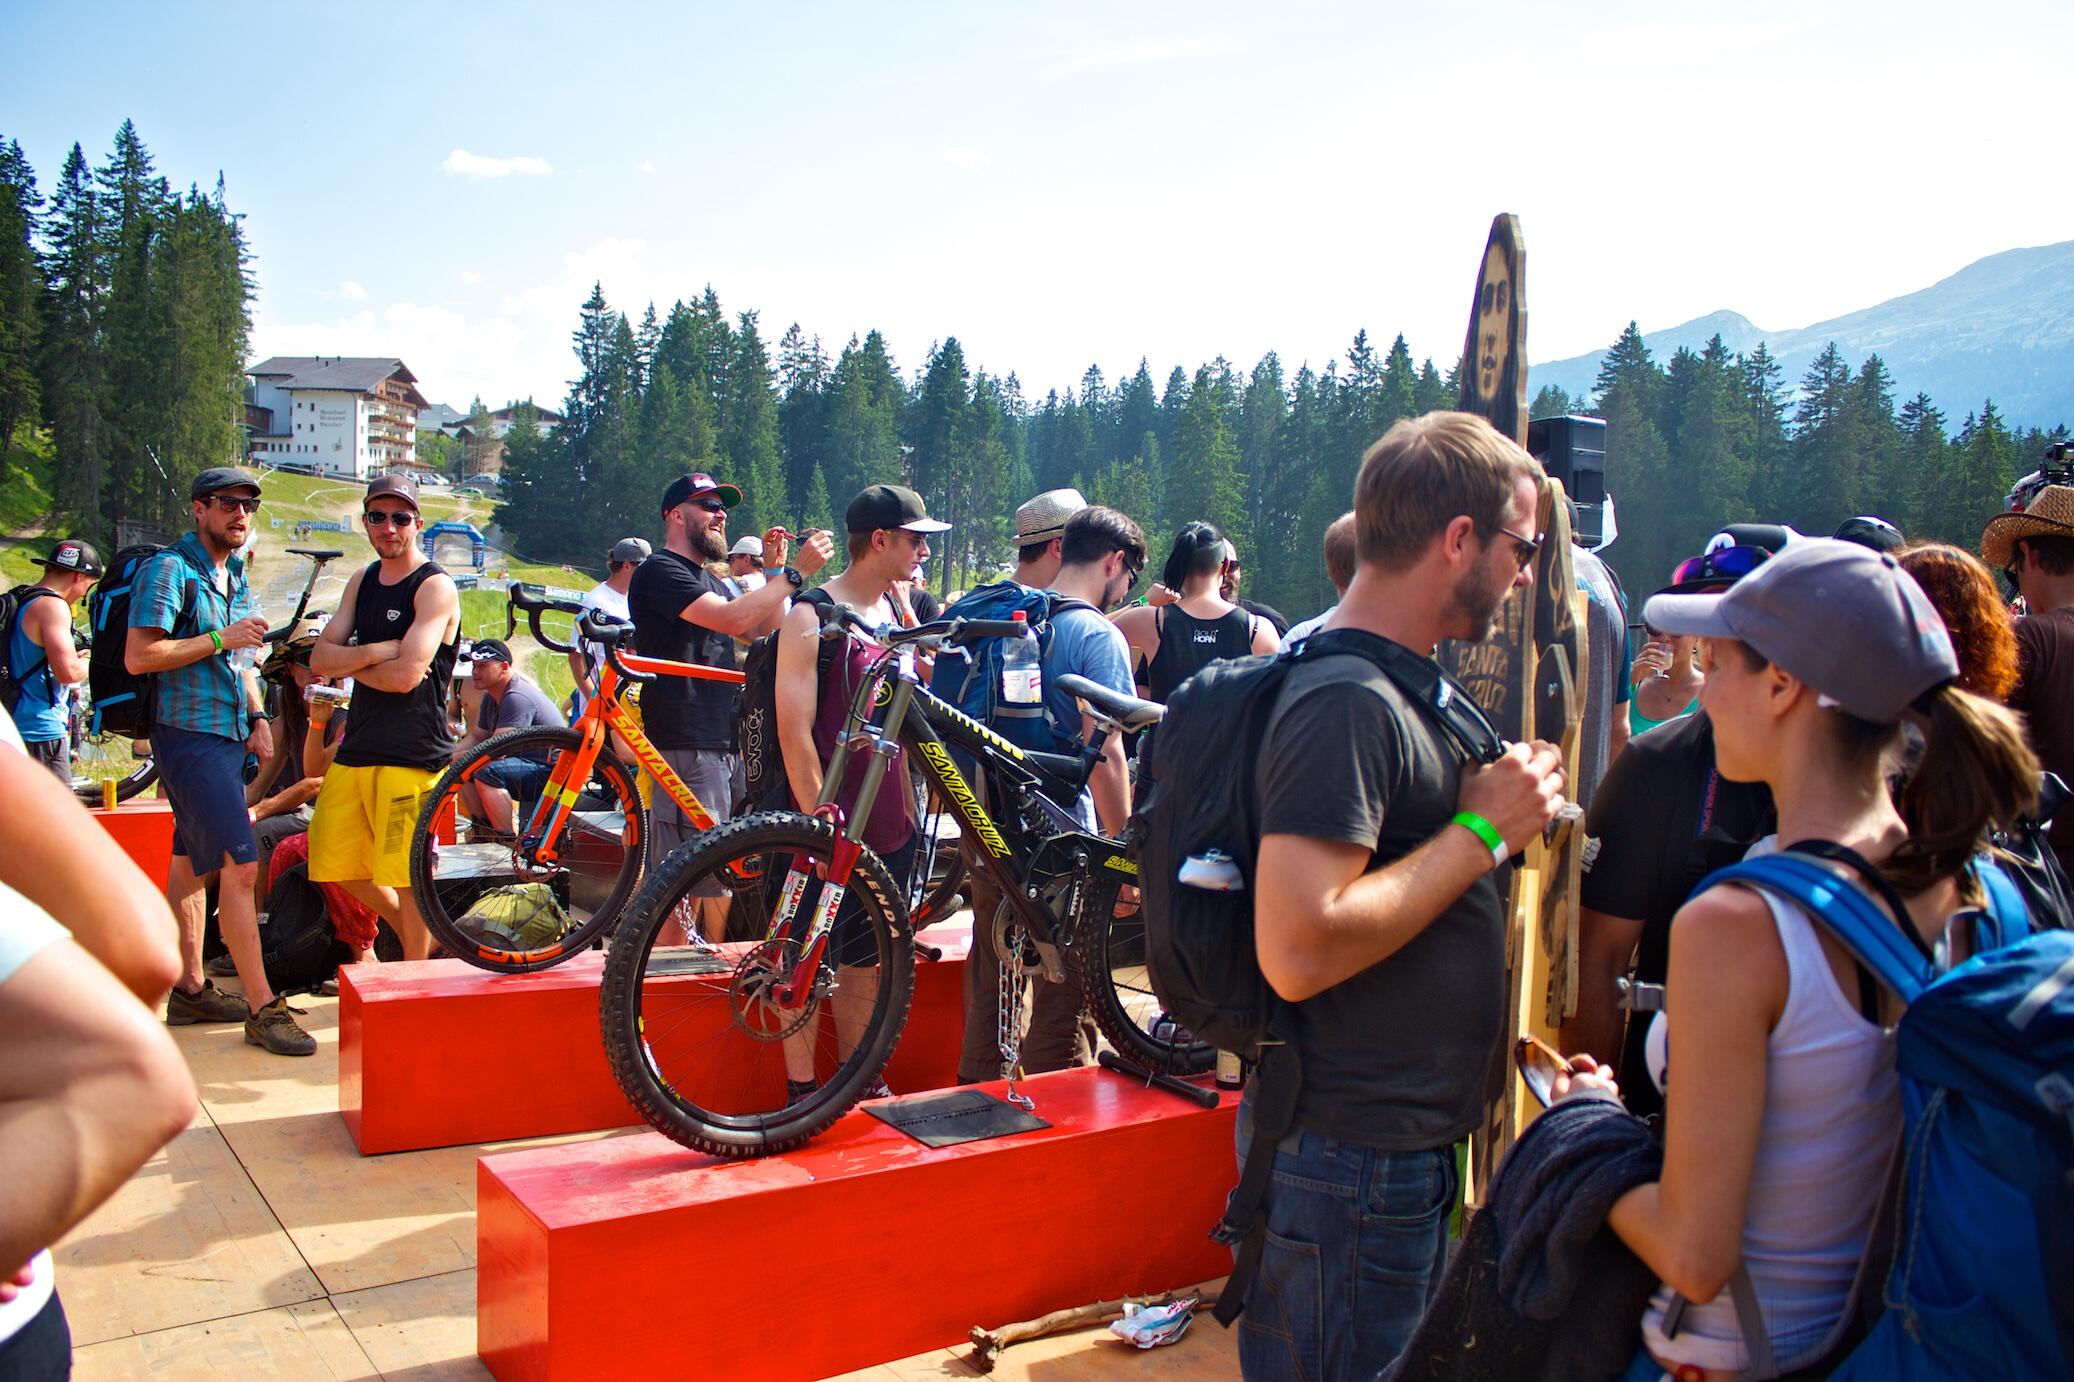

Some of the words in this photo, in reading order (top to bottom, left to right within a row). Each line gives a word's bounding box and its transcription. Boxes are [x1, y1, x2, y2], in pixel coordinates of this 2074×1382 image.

[1193, 635, 1217, 644] HORN
[1194, 629, 1217, 637] GOLD
[611, 715, 670, 775] SANTA
[661, 774, 706, 820] CRUZ
[917, 741, 976, 806] SANTA
[960, 803, 1012, 859] CRUZ
[854, 867, 900, 939] KENDA
